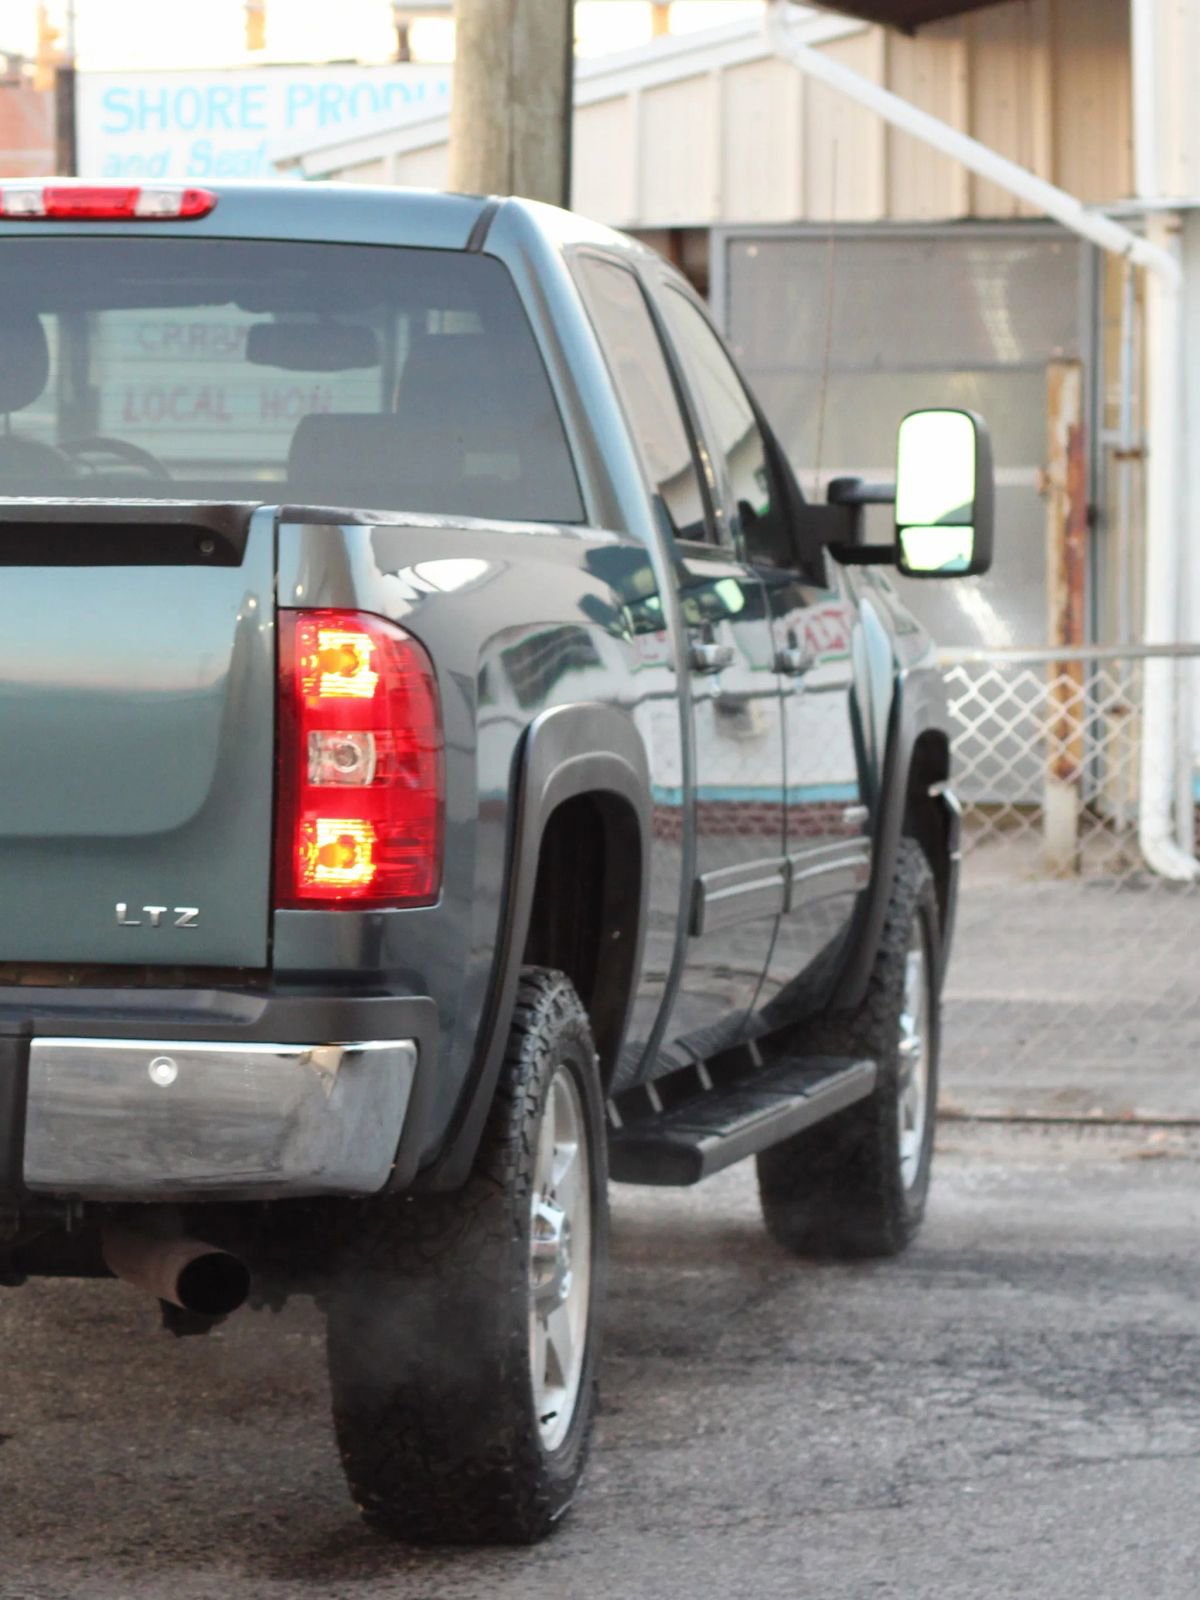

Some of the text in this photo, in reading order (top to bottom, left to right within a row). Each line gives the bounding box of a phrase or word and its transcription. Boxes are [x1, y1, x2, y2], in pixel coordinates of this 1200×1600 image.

[101, 84, 268, 133] SHORE
[122, 384, 233, 422] LOCAL
[115, 902, 199, 928] LTZ
